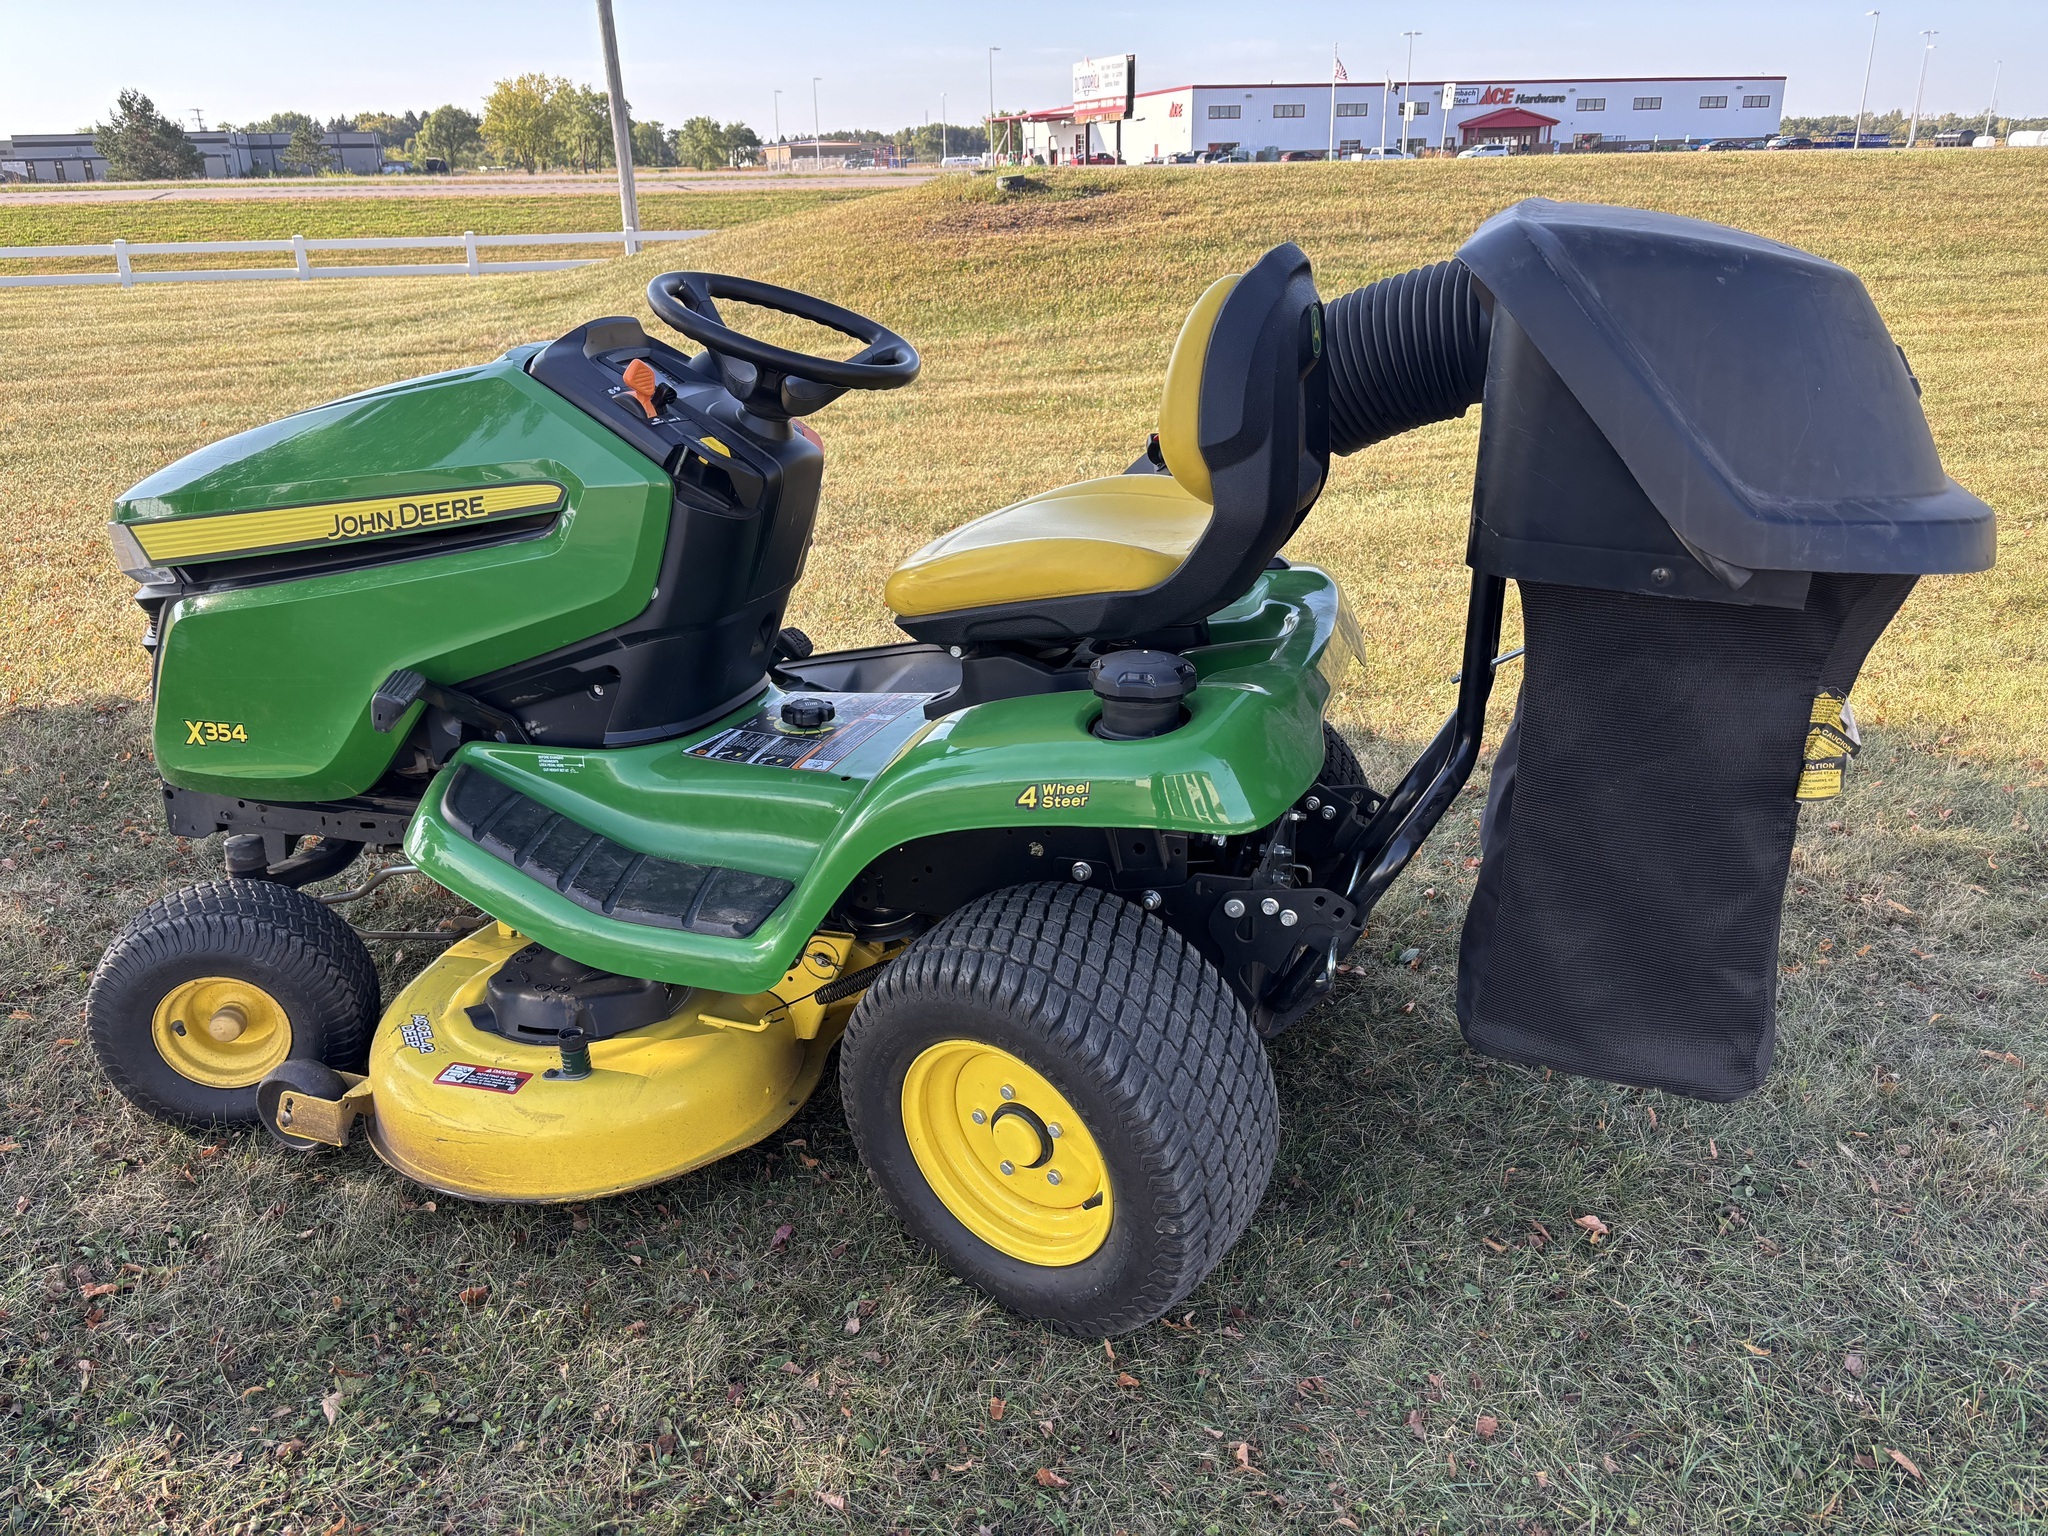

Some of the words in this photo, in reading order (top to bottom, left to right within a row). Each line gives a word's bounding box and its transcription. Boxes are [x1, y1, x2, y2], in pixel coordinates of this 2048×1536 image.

[1478, 85, 1515, 105] ACE
[1515, 93, 1567, 104] Hardware
[1169, 101, 1183, 117] ACE
[328, 510, 394, 537] JOHN
[399, 496, 485, 526] DEERE
[183, 720, 247, 745] X354
[1822, 729, 1853, 752] CAUCION
[1017, 785, 1038, 809] 4
[1042, 781, 1090, 796] Wheel
[1042, 795, 1089, 809] Steer
[400, 1024, 421, 1048] DEEP
